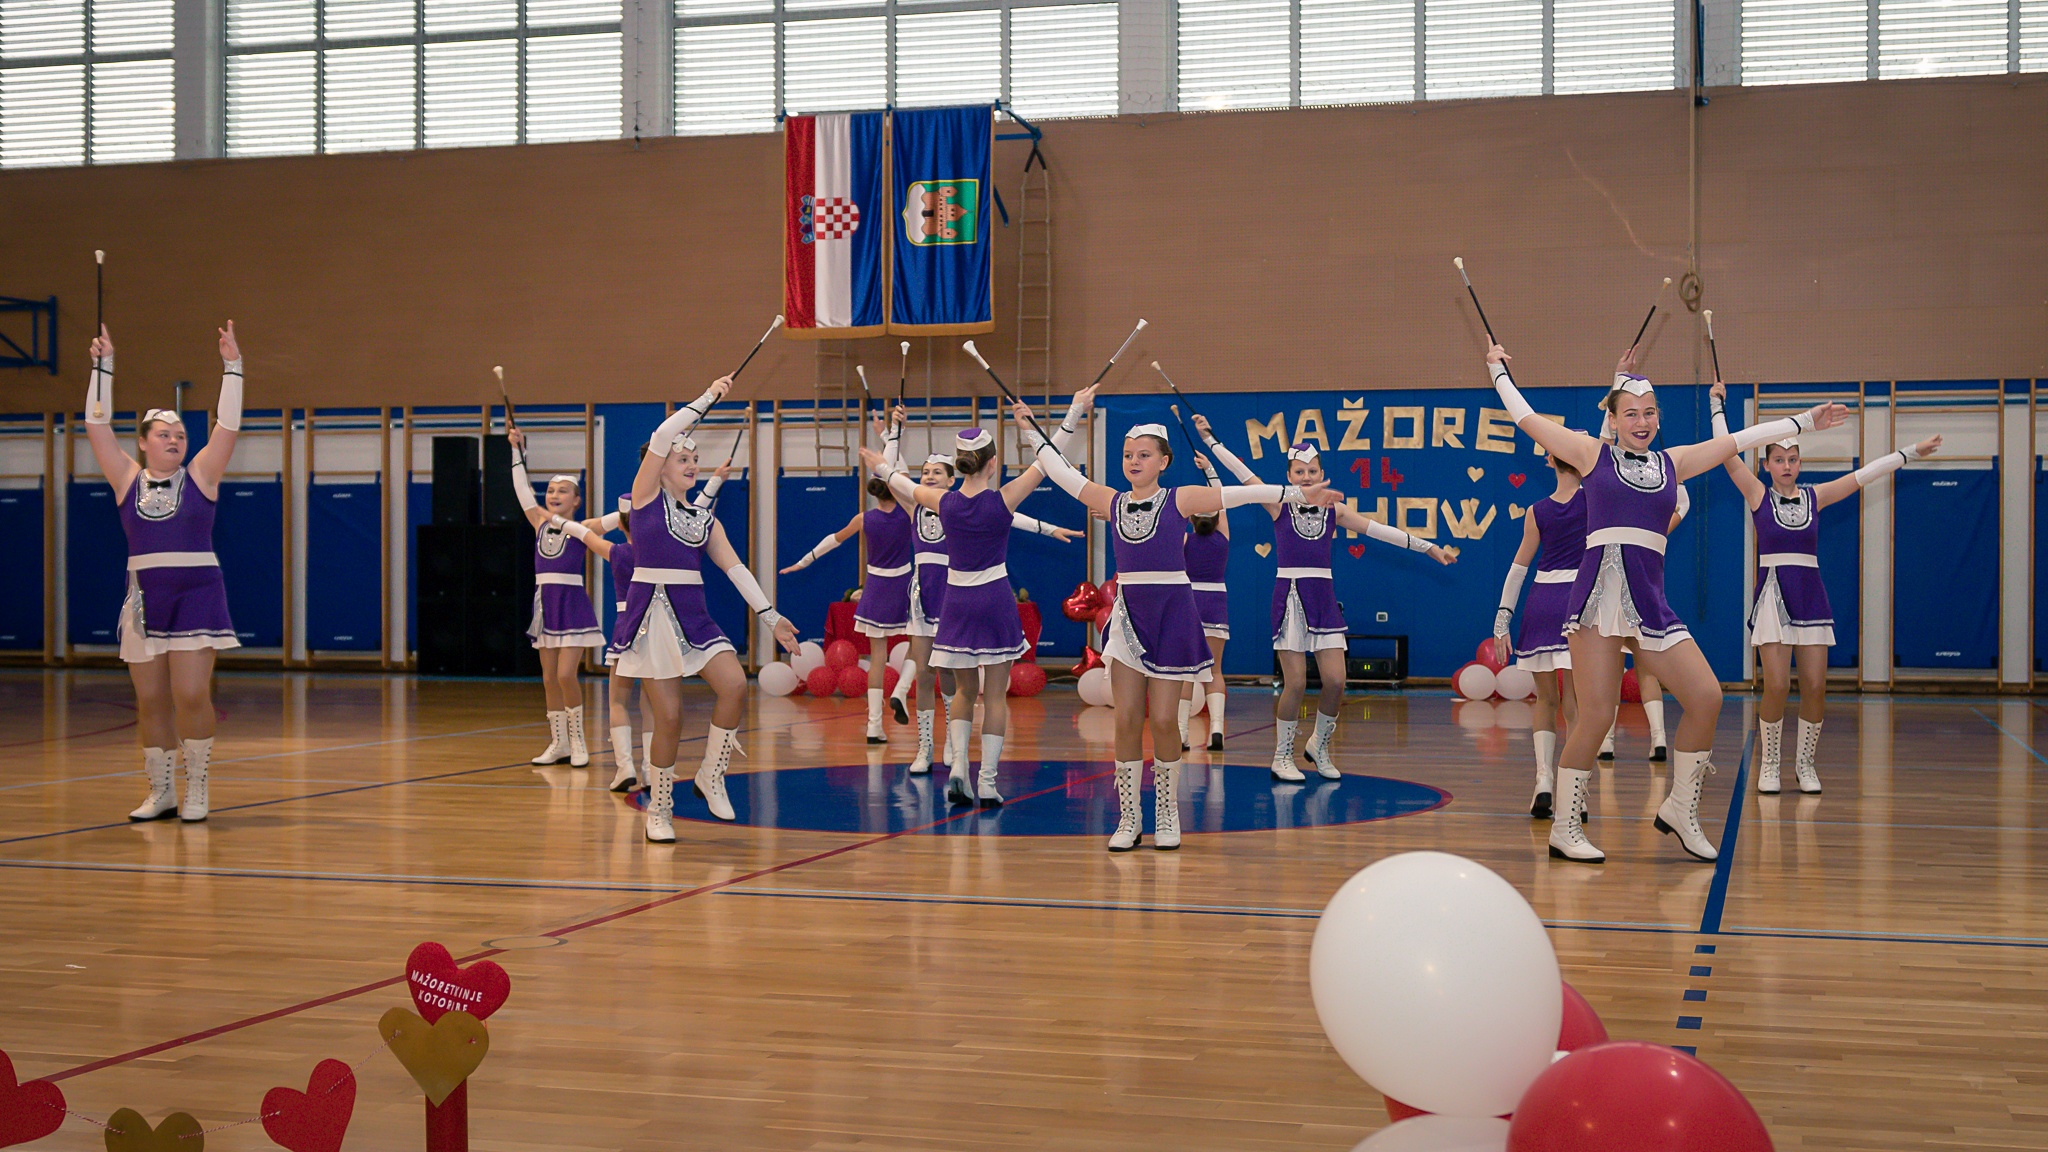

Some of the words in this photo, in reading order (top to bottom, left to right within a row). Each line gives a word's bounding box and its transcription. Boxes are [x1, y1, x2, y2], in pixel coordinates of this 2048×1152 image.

[1350, 457, 1404, 491] 14
[1333, 496, 1497, 540] HOW
[411, 969, 483, 1003] MAŽORETKINJE
